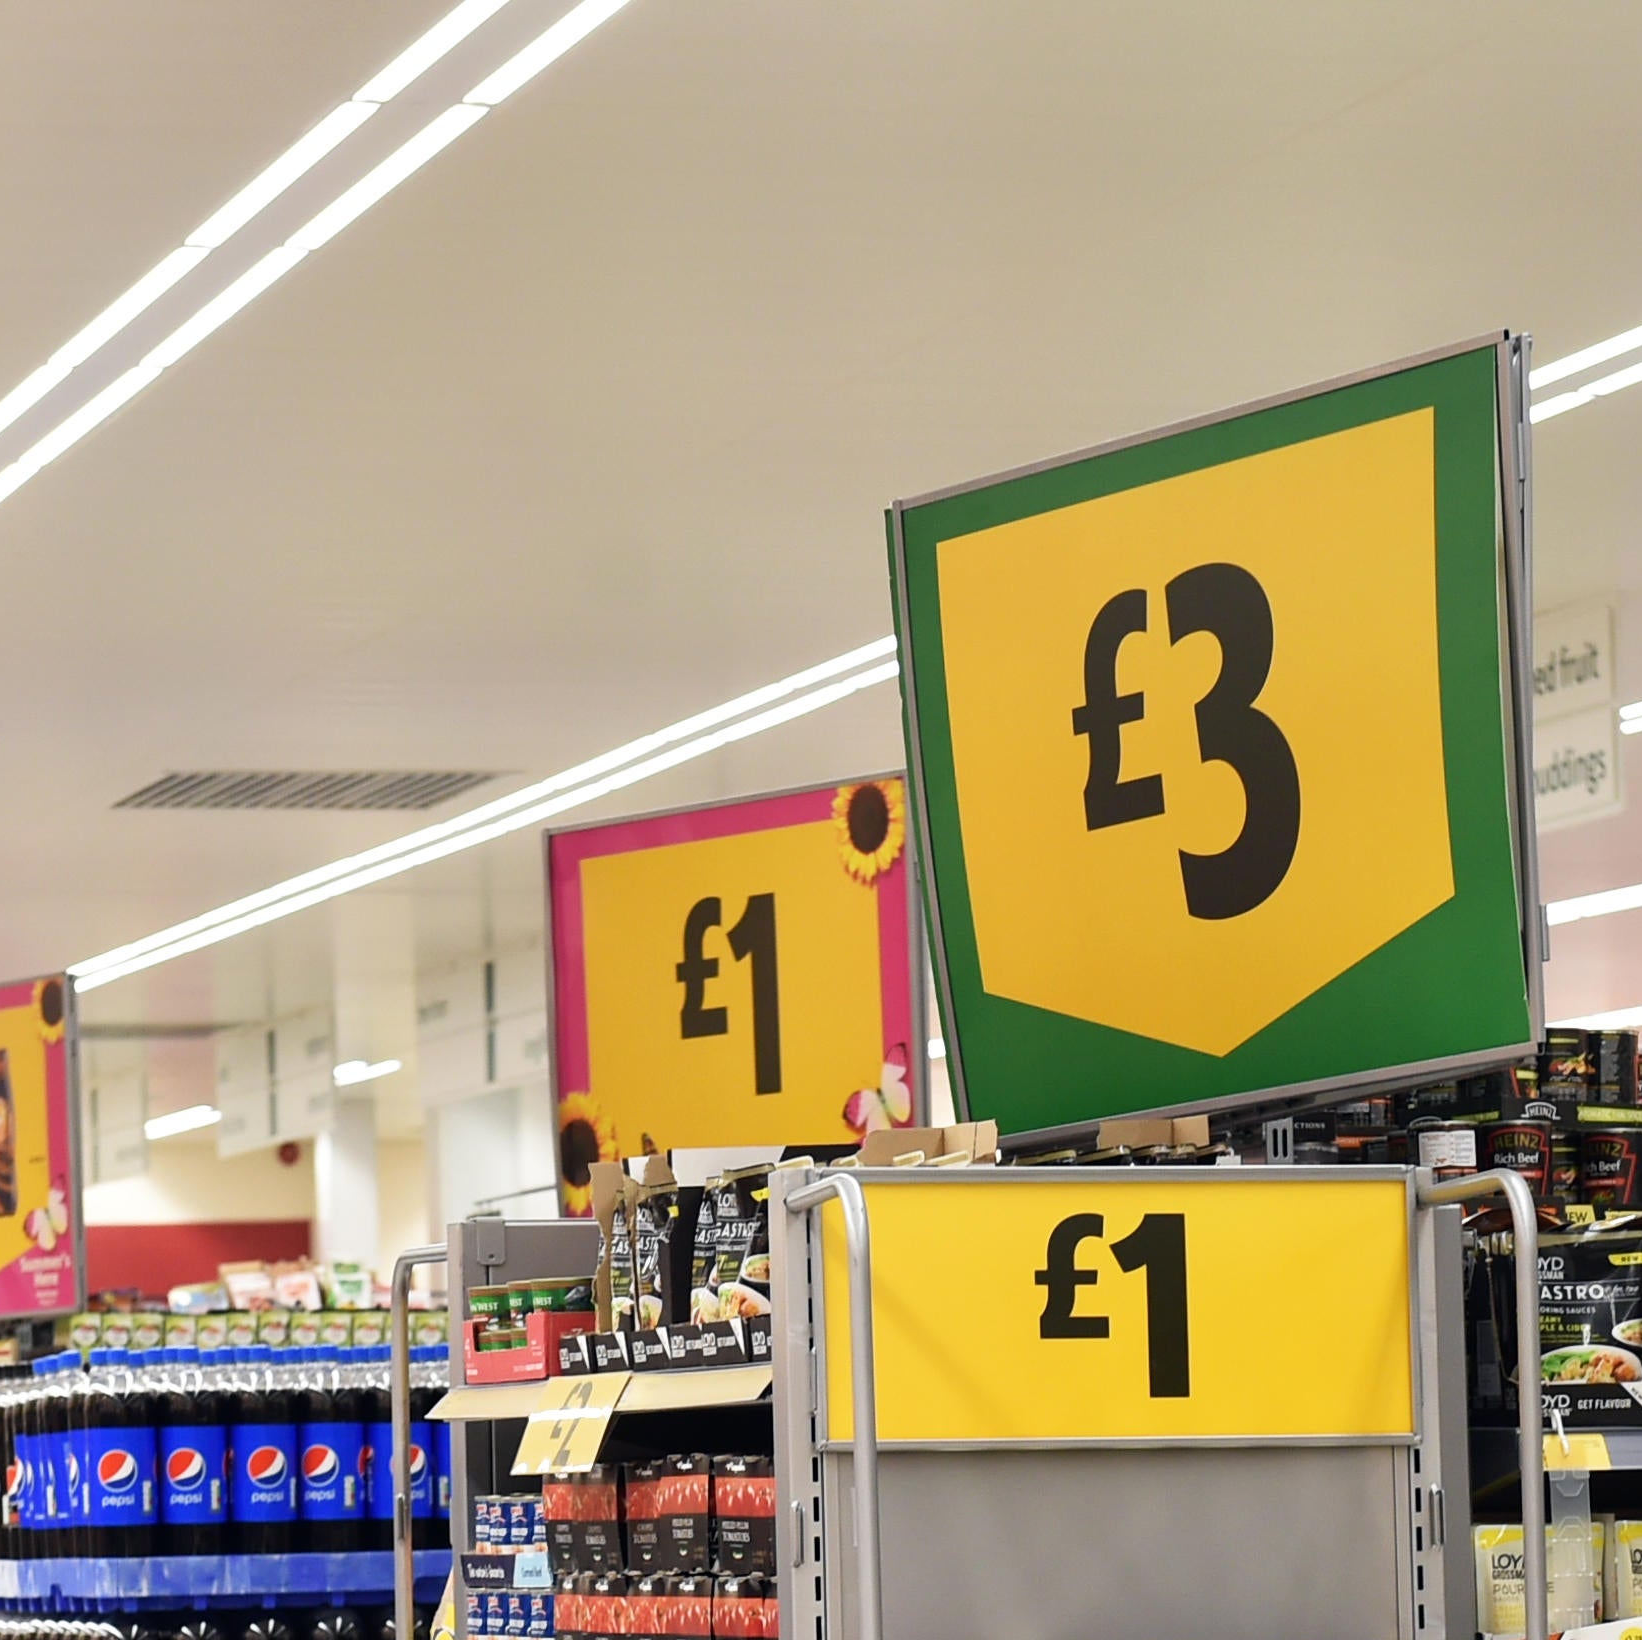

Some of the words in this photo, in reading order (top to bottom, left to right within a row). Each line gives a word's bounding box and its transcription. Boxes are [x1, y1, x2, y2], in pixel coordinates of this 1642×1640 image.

[1071, 561, 1301, 920] £3
[674, 891, 781, 1097] £1
[1530, 1106, 1555, 1118] HEINZ
[1494, 1134, 1539, 1149] HEINZ
[1494, 1153, 1515, 1165] Rich
[1517, 1152, 1539, 1165] Beef
[1035, 1213, 1190, 1398] £1
[102, 1492, 135, 1508] pepsi
[251, 1490, 284, 1504] pepsi
[305, 1488, 336, 1503] pepsi
